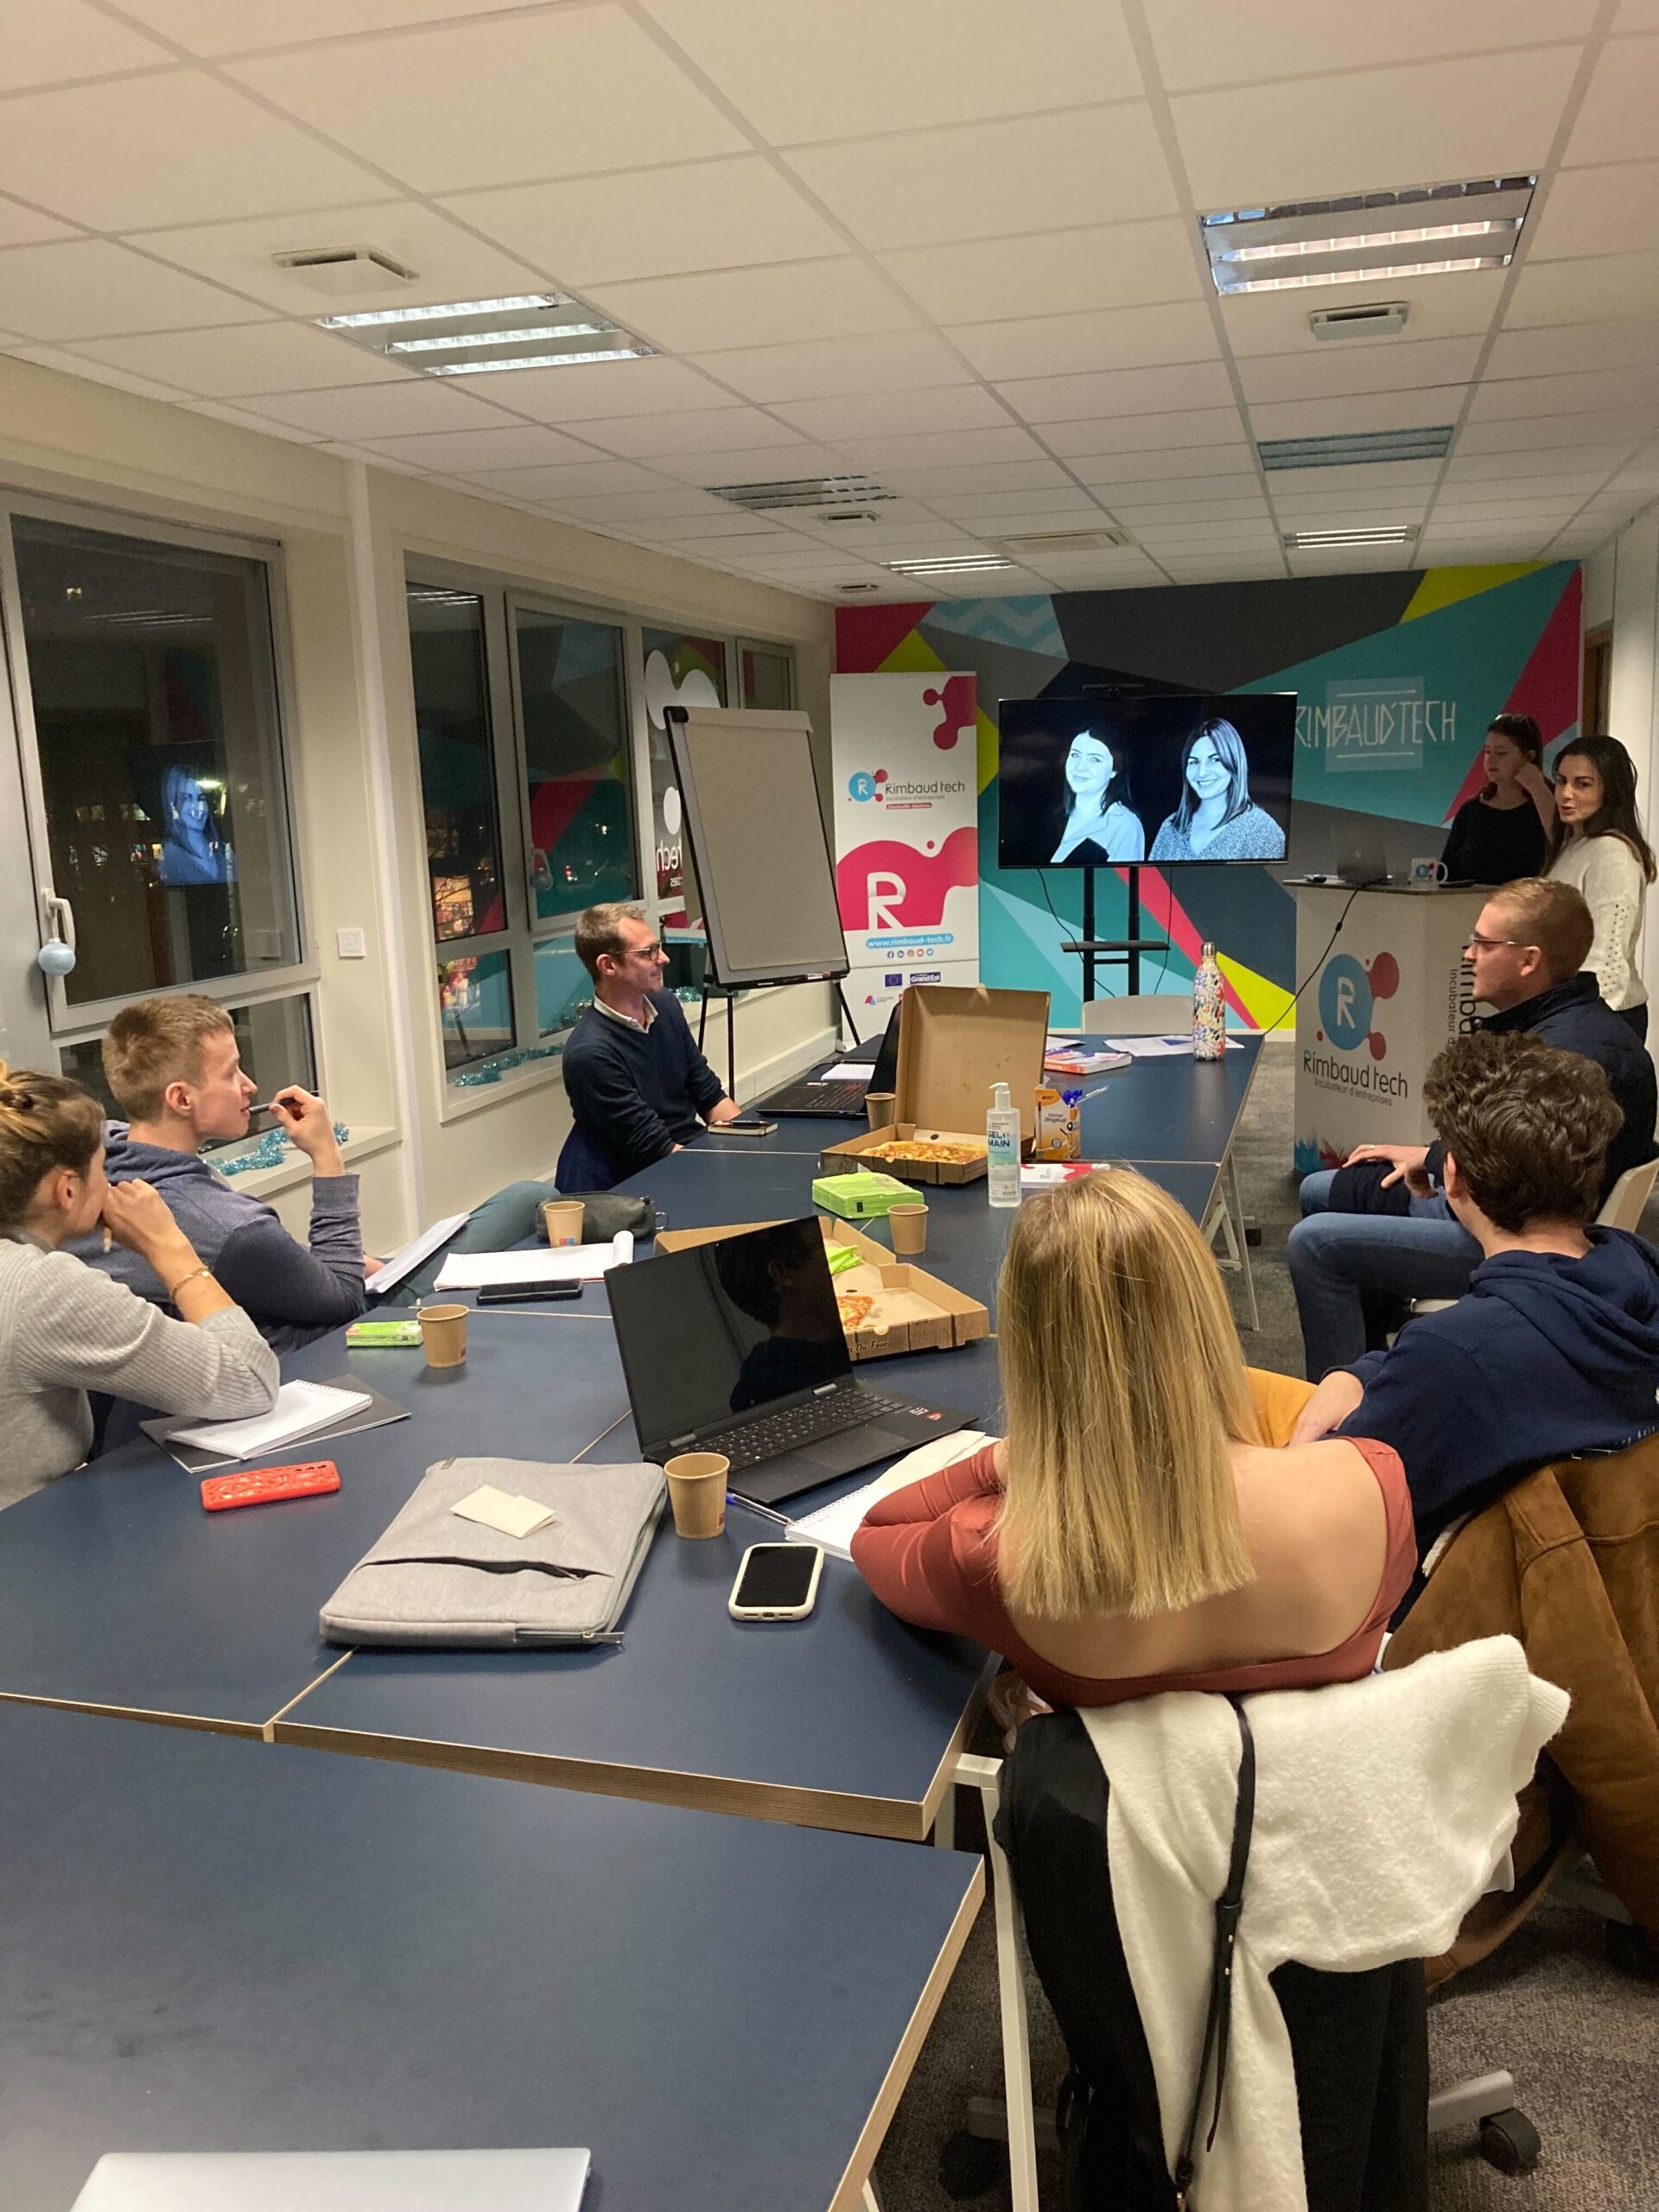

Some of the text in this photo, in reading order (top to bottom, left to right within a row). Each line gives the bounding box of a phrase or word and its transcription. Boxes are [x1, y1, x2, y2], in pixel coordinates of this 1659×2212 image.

[857, 779, 868, 796] R
[885, 780, 965, 795] Rimbaud tech
[867, 871, 906, 931] R
[868, 934, 952, 947] www.rimbaud-tech.fr
[1337, 976, 1356, 1030] R
[1447, 969, 1459, 1033] Incubateur
[1303, 1049, 1408, 1099] Rimbaud tech
[870, 1341, 888, 1350] Four
